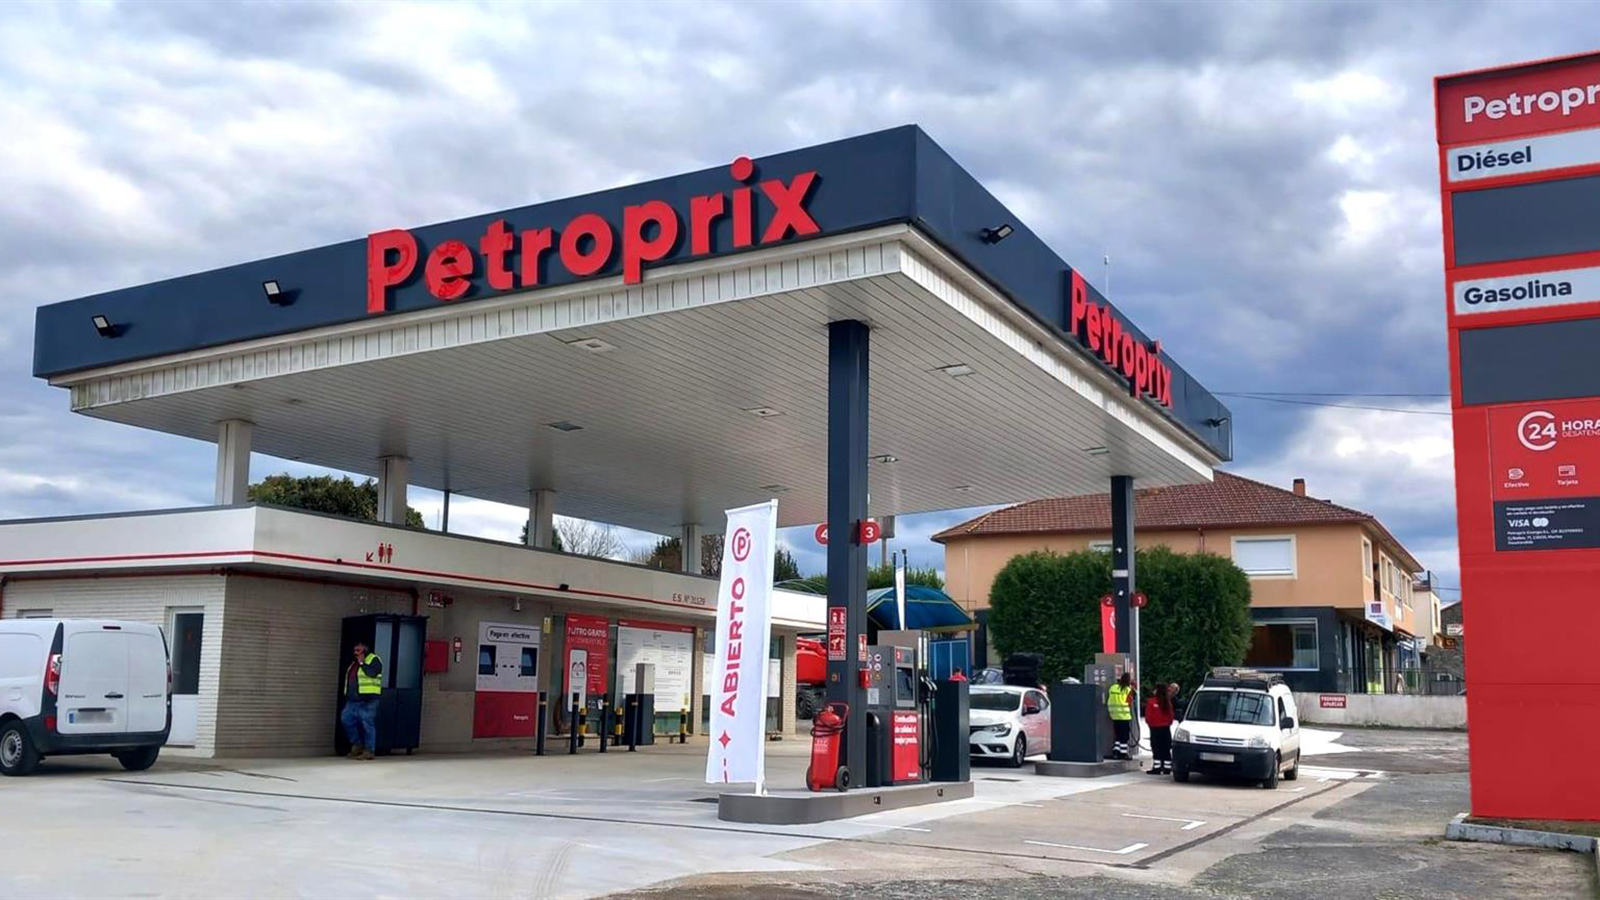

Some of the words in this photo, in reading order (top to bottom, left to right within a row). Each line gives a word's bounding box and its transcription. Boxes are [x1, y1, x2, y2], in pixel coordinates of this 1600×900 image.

[1464, 84, 1600, 123] Petropr
[1457, 146, 1532, 171] Diésel
[367, 156, 822, 314] Petroprix
[1464, 279, 1573, 305] Gasolina
[1070, 267, 1173, 410] Petroprix
[1528, 422, 1557, 439] 24
[865, 526, 874, 538] 3
[1508, 519, 1530, 527] VISA
[490, 630, 502, 639] Pago
[721, 577, 745, 717] ABIERTO
